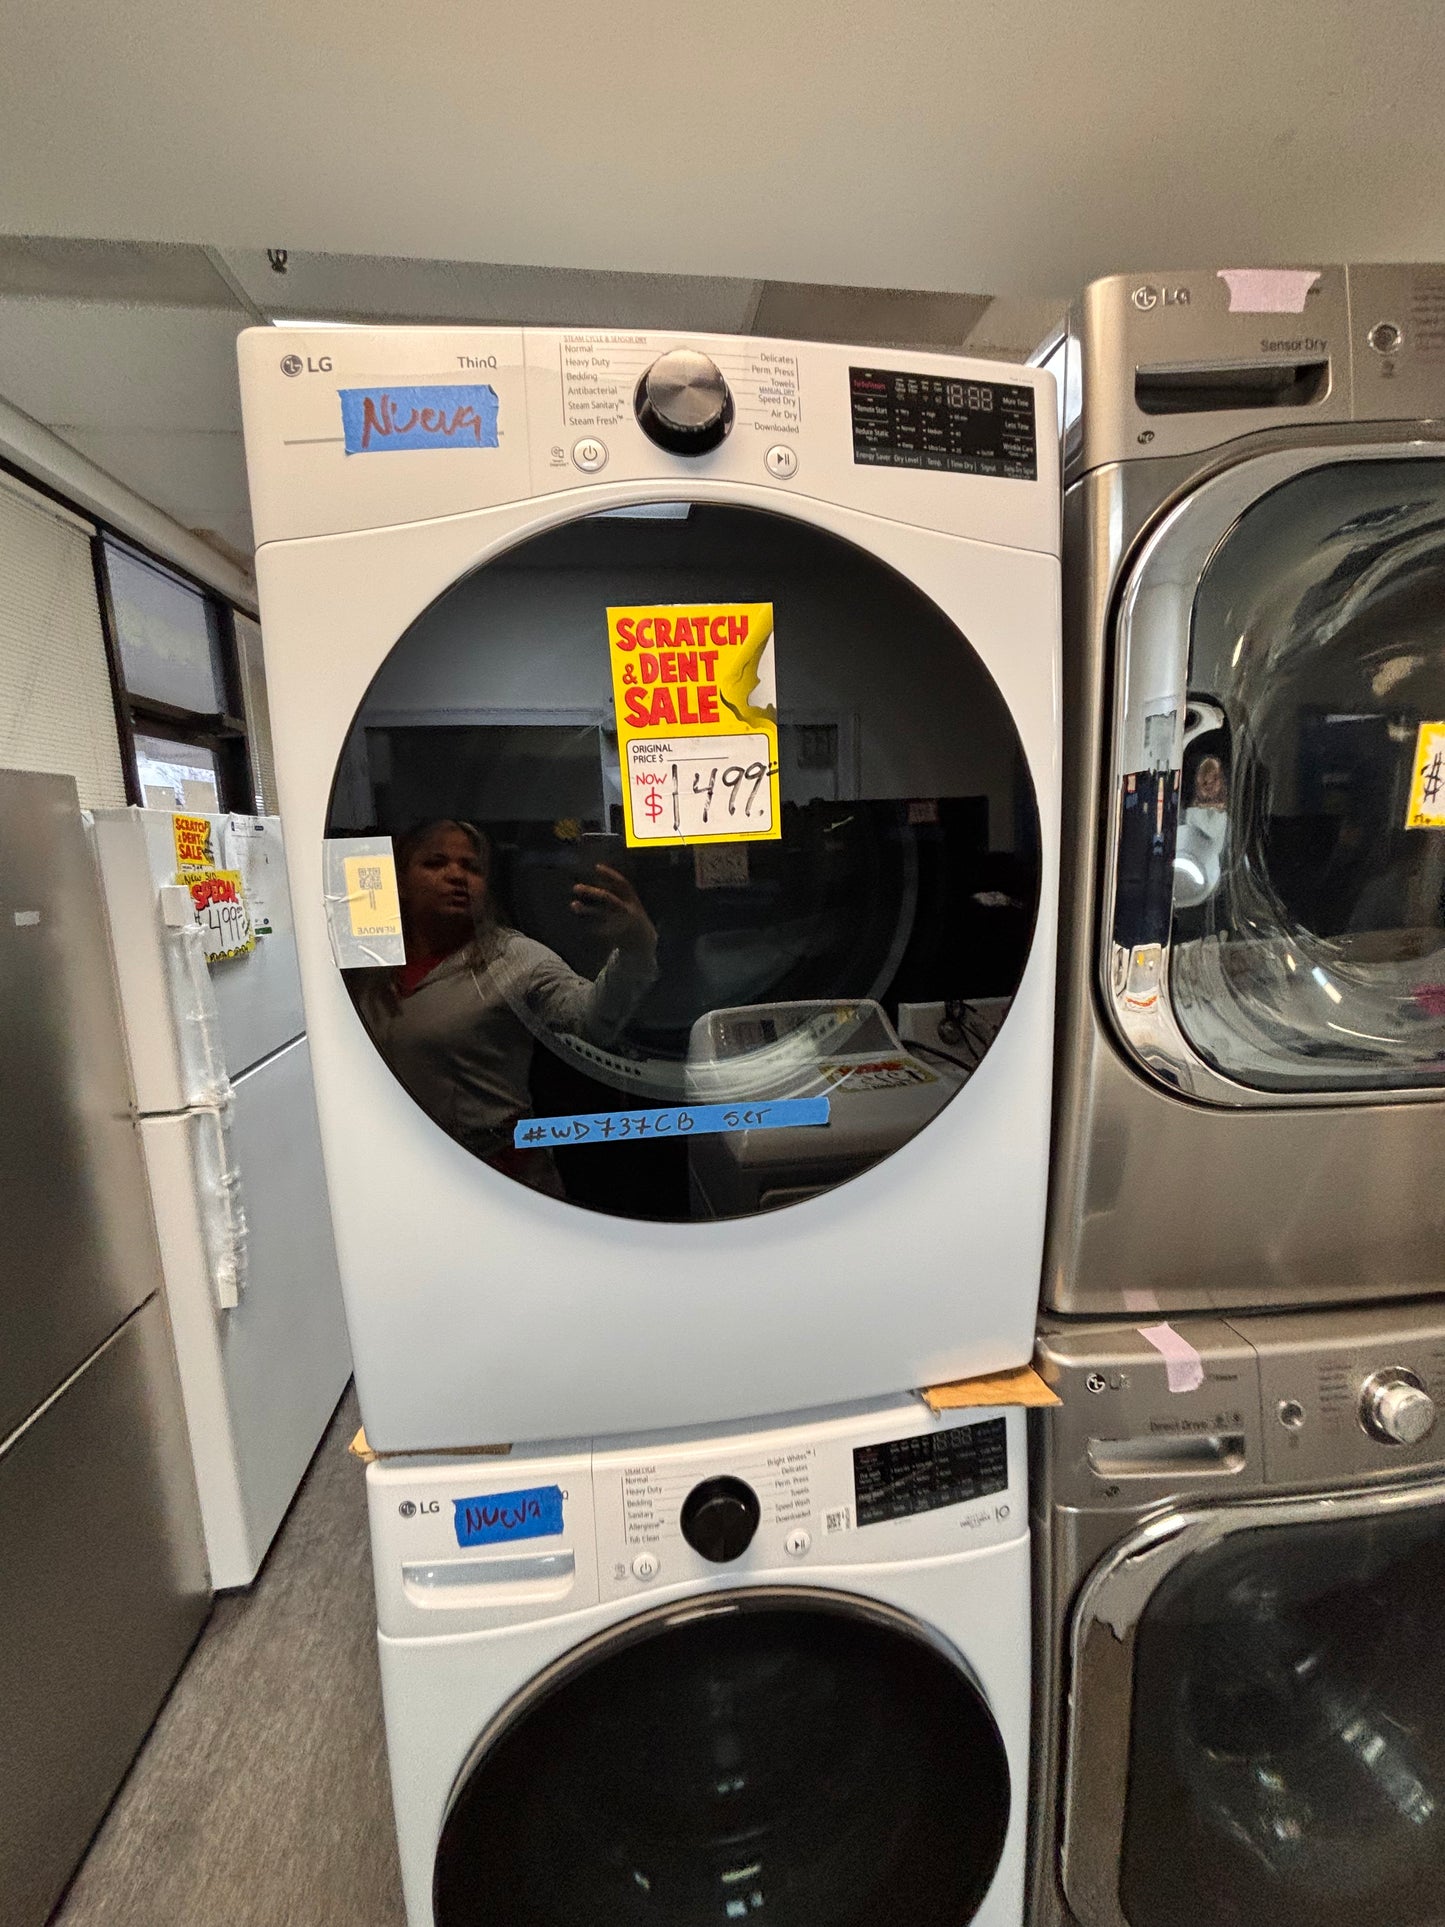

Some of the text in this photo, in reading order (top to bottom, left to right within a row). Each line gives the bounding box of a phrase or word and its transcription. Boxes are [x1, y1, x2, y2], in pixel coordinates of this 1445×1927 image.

[564, 344, 594, 353] Normal
[1260, 338, 1328, 353] Sensor Dry
[306, 356, 333, 373] LG
[456, 355, 498, 370] ThinQ
[565, 358, 610, 368] Heavy Duty
[760, 352, 795, 365] Delicates
[566, 372, 598, 382] Bedding
[751, 365, 795, 377] Perm. Press
[770, 378, 795, 389] Towels
[567, 386, 618, 396] Antibacterial
[568, 401, 590, 411] Steam
[758, 395, 796, 408] Speed Dry
[771, 409, 798, 421] Air Dry
[568, 417, 594, 426] Steam
[754, 422, 800, 434] Downloaded
[615, 615, 750, 652] SCRATCH
[622, 650, 719, 685] & DENT
[623, 685, 721, 729] SALE
[632, 743, 673, 754] ORIGINAL
[633, 754, 664, 764] PRICE $
[635, 772, 668, 786] NOW
[644, 786, 663, 824] $
[178, 843, 203, 861] SALE
[357, 925, 396, 936] REMOVE
[625, 1475, 649, 1485] Normal
[626, 1485, 662, 1497] Heavy Duty
[419, 1500, 440, 1514] LG
[627, 1499, 653, 1509] Bedding
[775, 1509, 811, 1524] Downloaded
